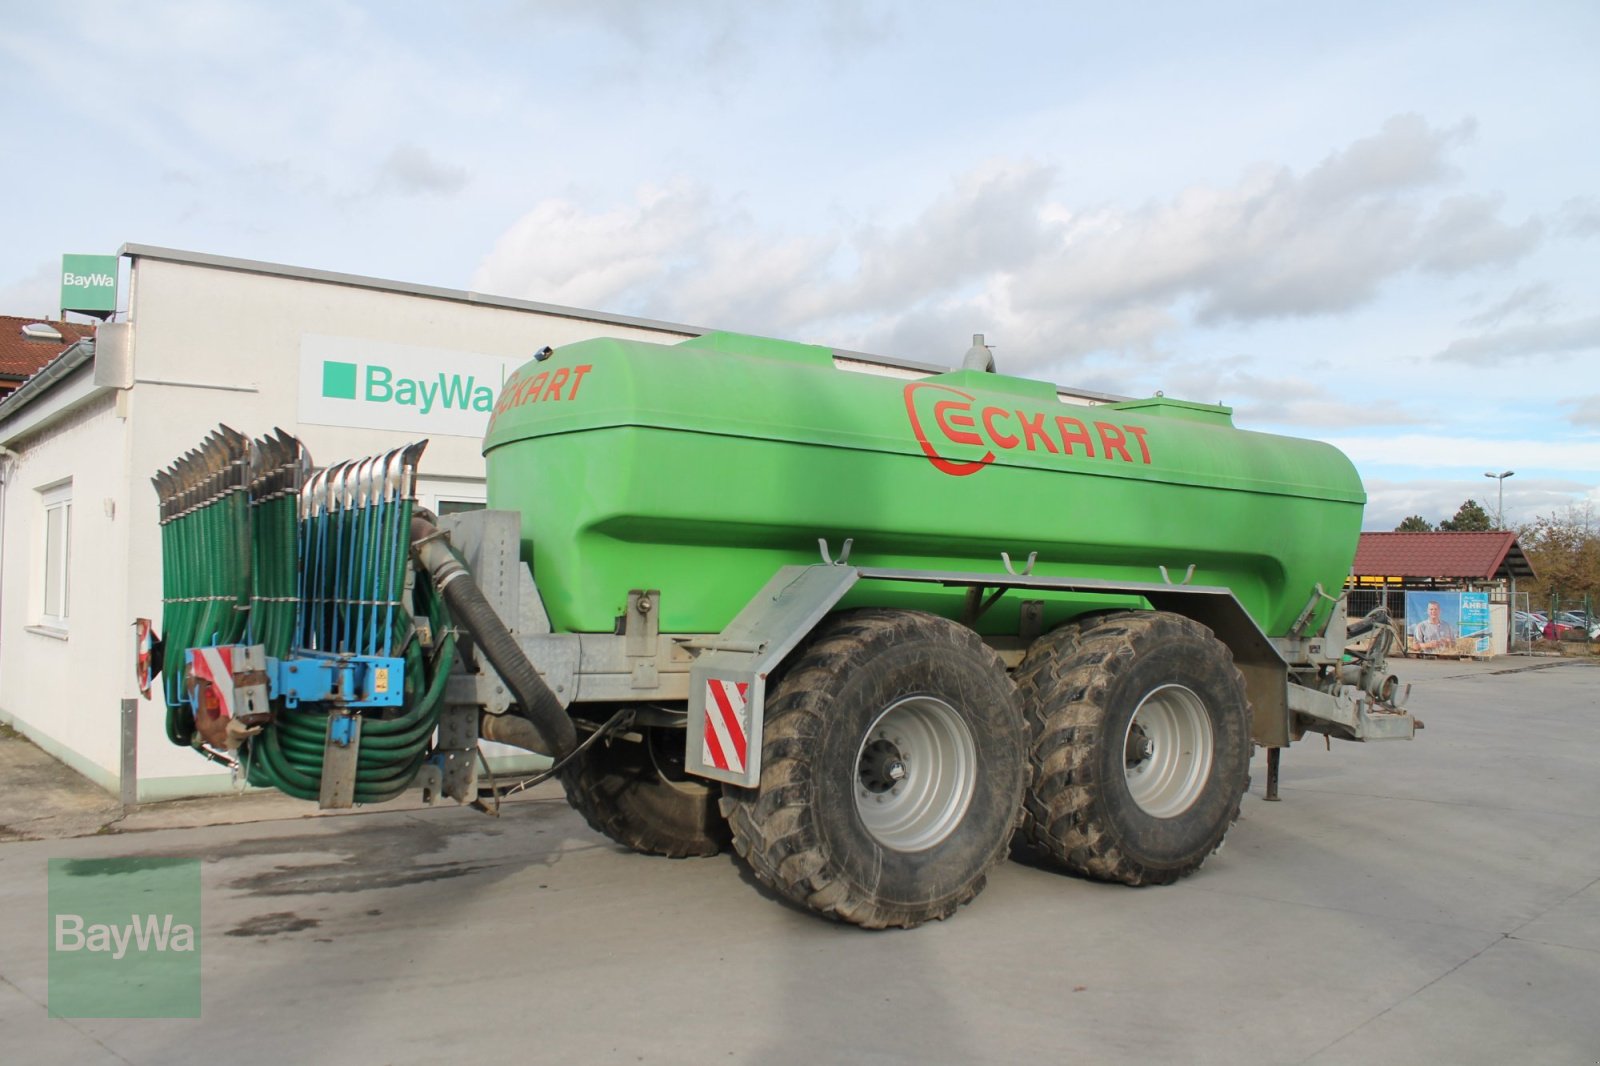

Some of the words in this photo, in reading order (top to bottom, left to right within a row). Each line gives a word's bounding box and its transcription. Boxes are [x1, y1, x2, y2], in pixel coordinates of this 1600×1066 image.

[63, 272, 114, 288] BayWa
[365, 364, 493, 415] BayWa
[497, 364, 593, 415] CKART
[932, 399, 1152, 464] ECKART
